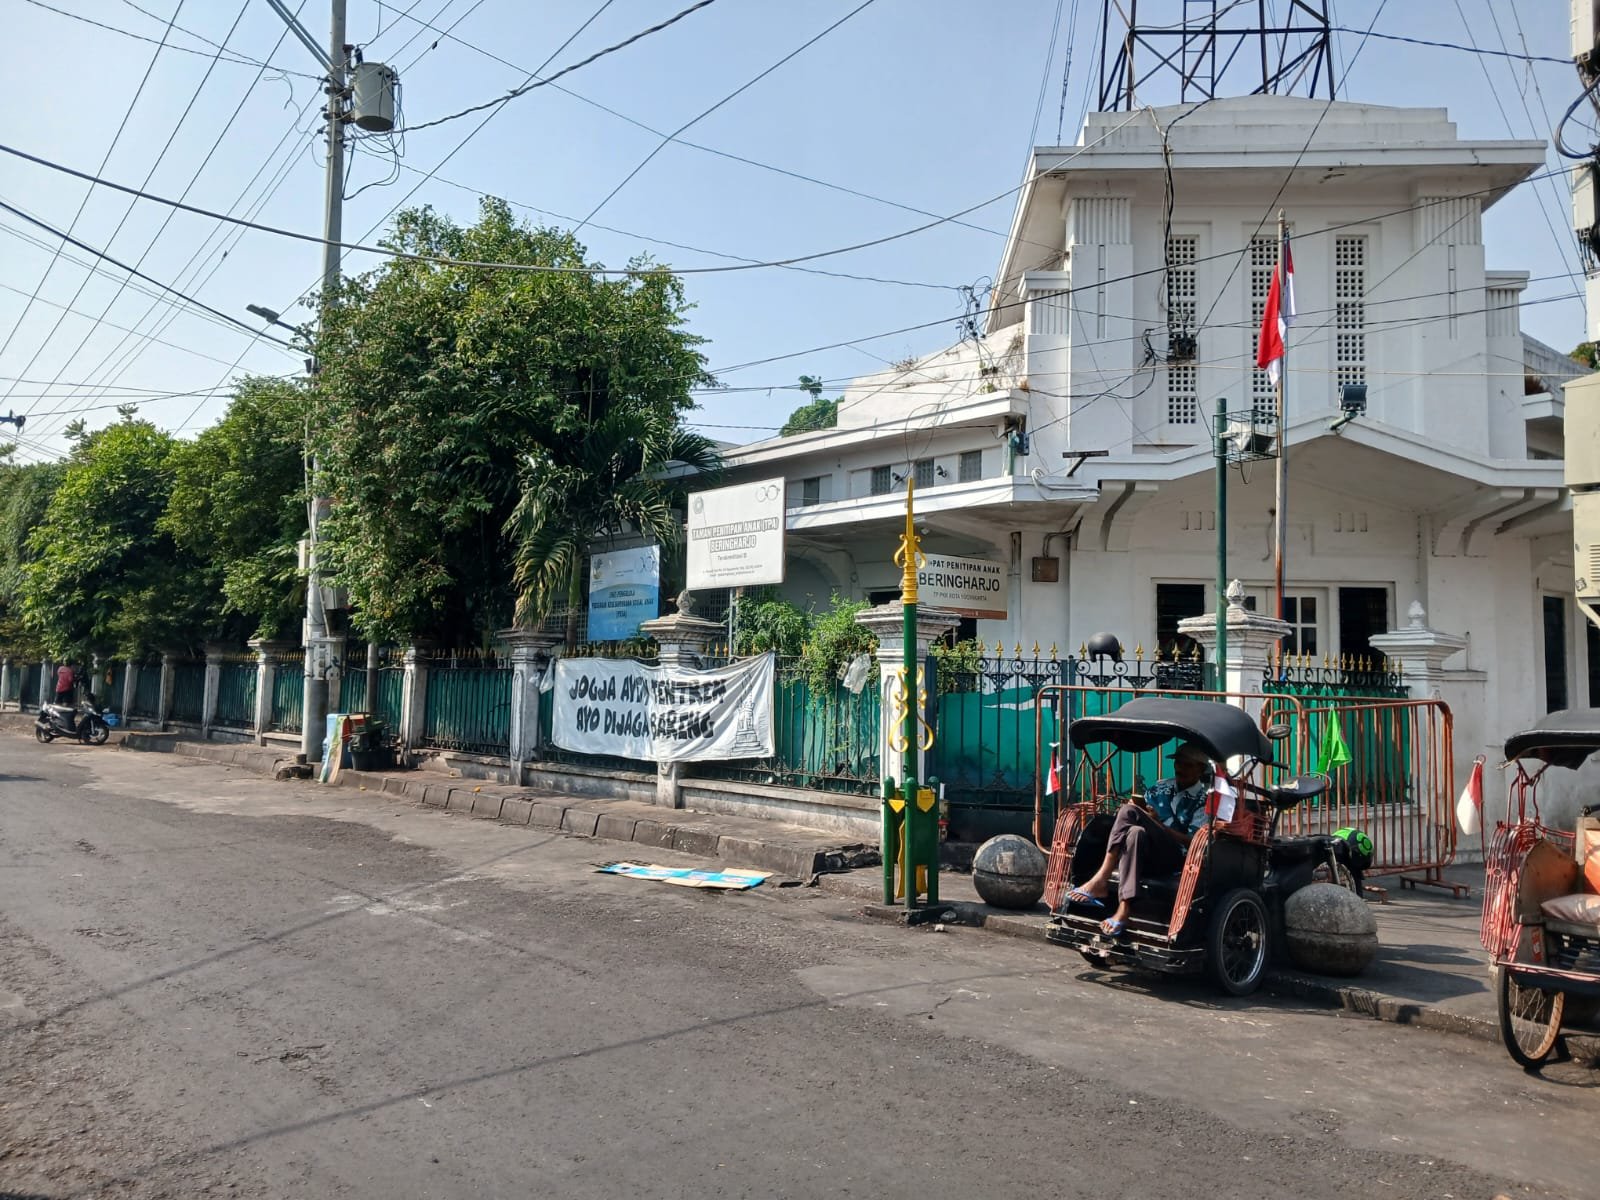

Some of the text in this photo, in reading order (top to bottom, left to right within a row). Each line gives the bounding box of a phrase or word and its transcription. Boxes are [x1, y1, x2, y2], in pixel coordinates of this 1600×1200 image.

[744, 518, 761, 534] ANAK
[762, 516, 779, 532] (TPA)
[710, 535, 757, 553] BERINGHARJO
[946, 561, 982, 572] PENITIPAN
[983, 565, 1001, 574] ANAK
[919, 572, 1000, 592] BERINGHARJO
[568, 674, 616, 701] JOGJA
[651, 678, 727, 705] TENTREM
[576, 705, 715, 741] AYO DIJAGA BARENG
